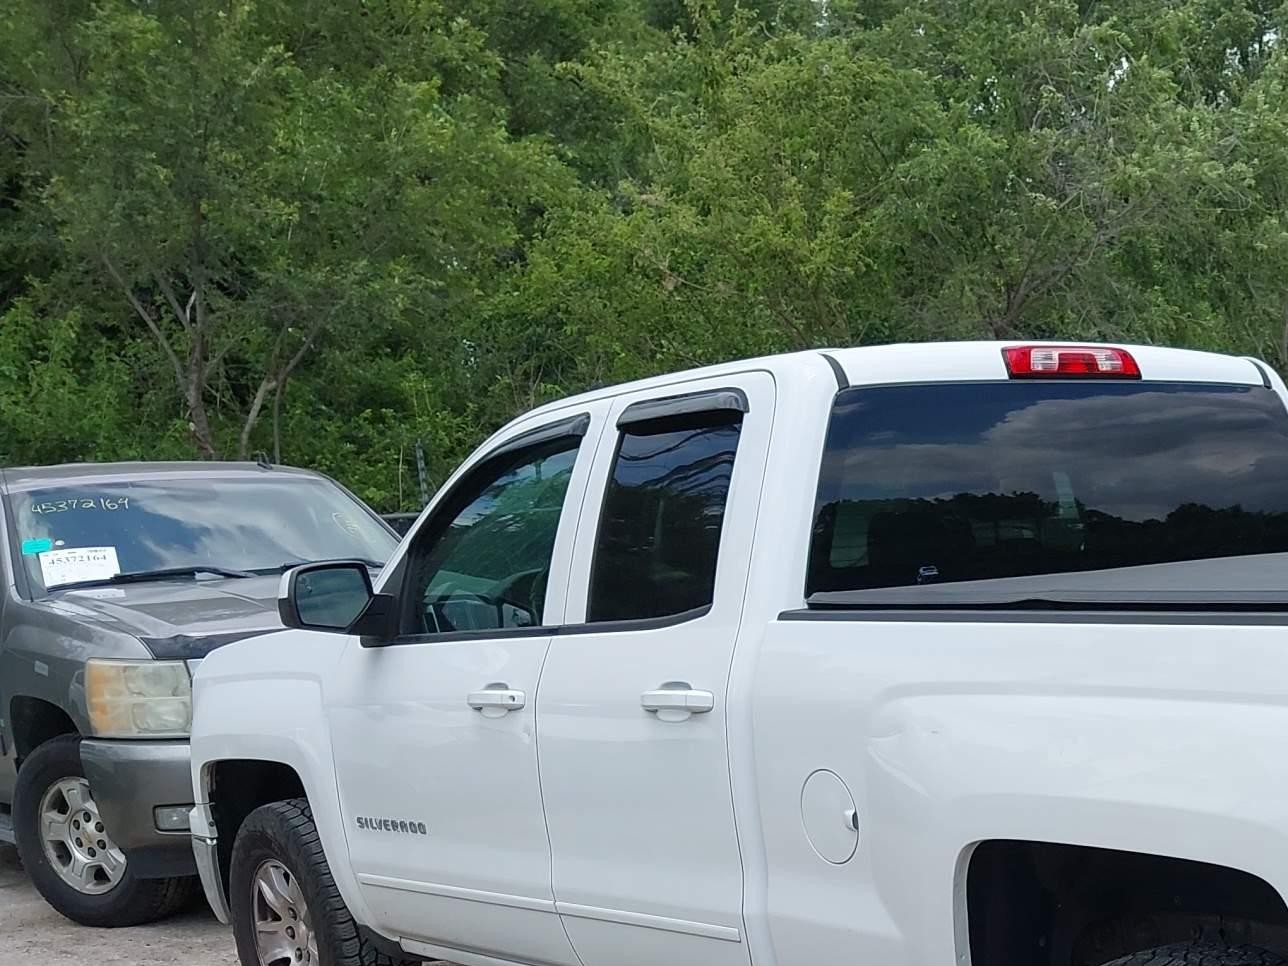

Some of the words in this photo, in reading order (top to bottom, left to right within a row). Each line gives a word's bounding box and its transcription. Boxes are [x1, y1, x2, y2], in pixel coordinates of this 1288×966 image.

[31, 497, 129, 514] 45372164
[48, 553, 108, 566] 45372164
[356, 816, 427, 835] SILVERADO
